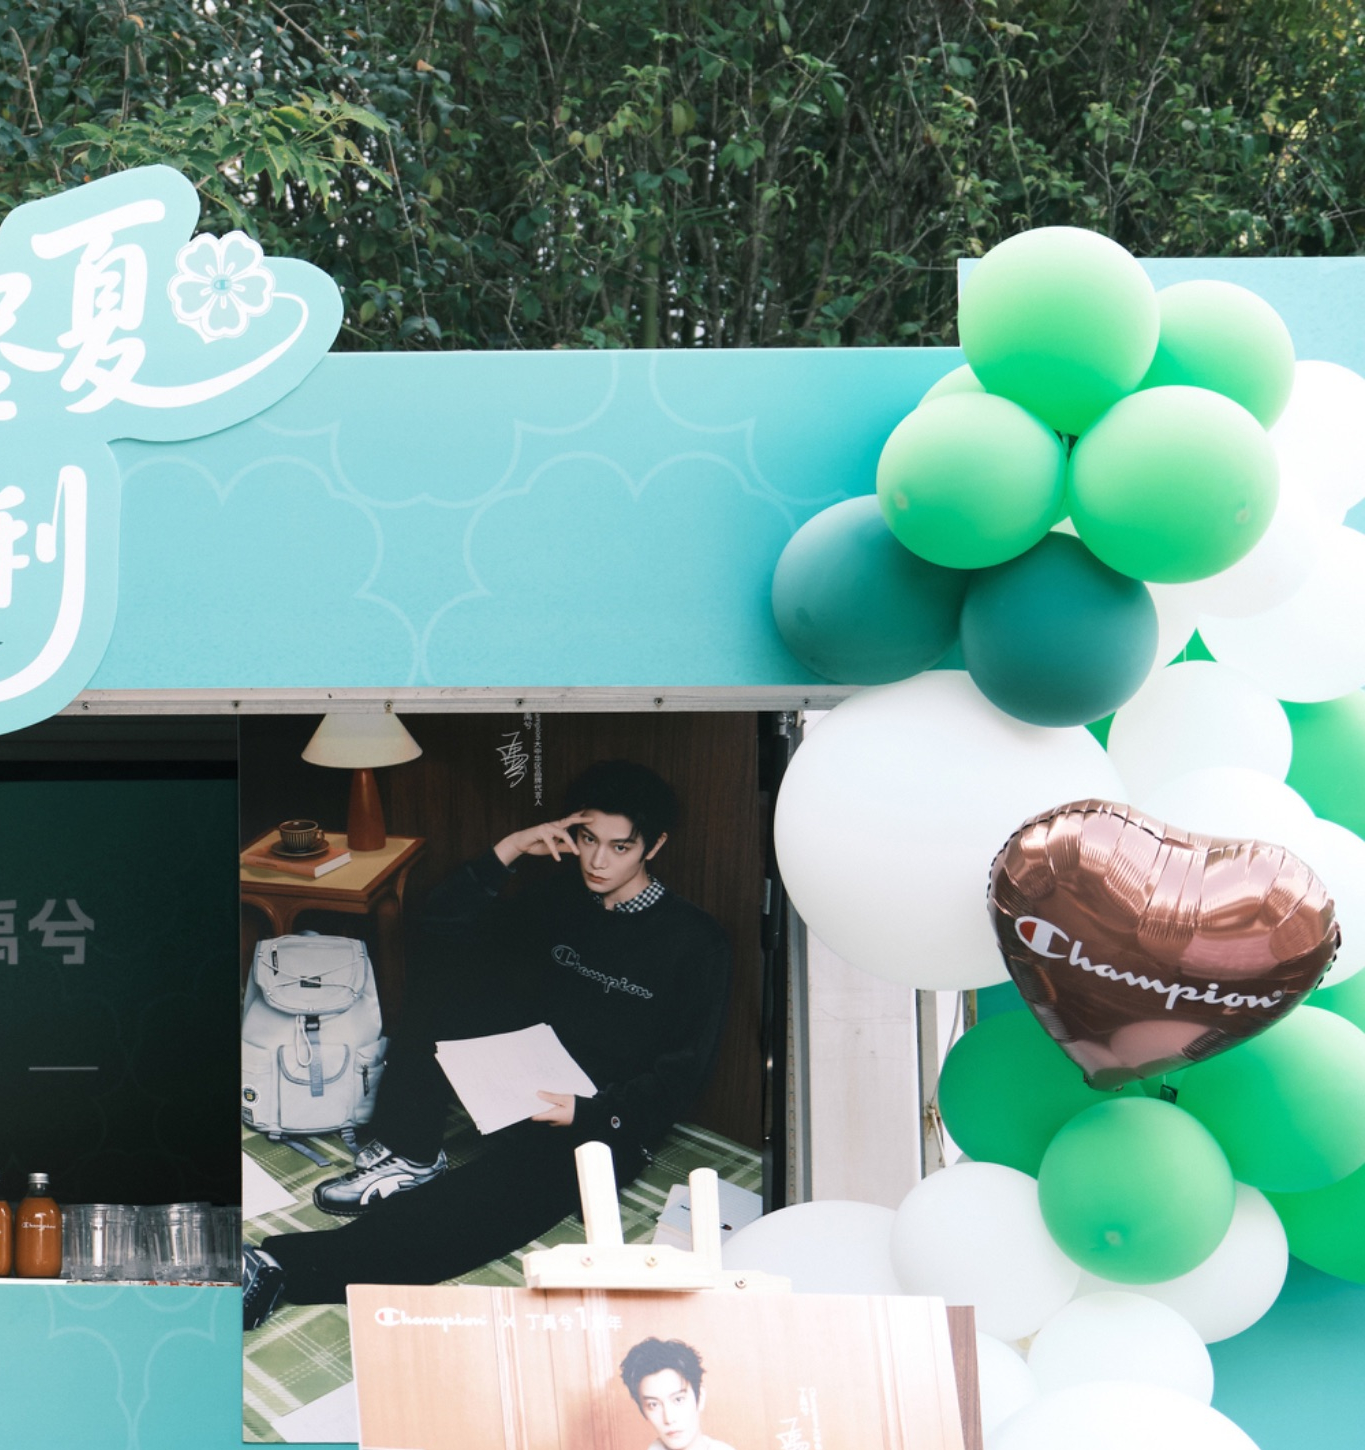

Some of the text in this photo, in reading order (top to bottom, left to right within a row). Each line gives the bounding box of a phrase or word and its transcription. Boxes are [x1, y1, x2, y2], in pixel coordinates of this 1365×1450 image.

[551, 944, 654, 999] Champion
[1013, 915, 1286, 1010] Champion
[374, 1307, 488, 1334] Champion
